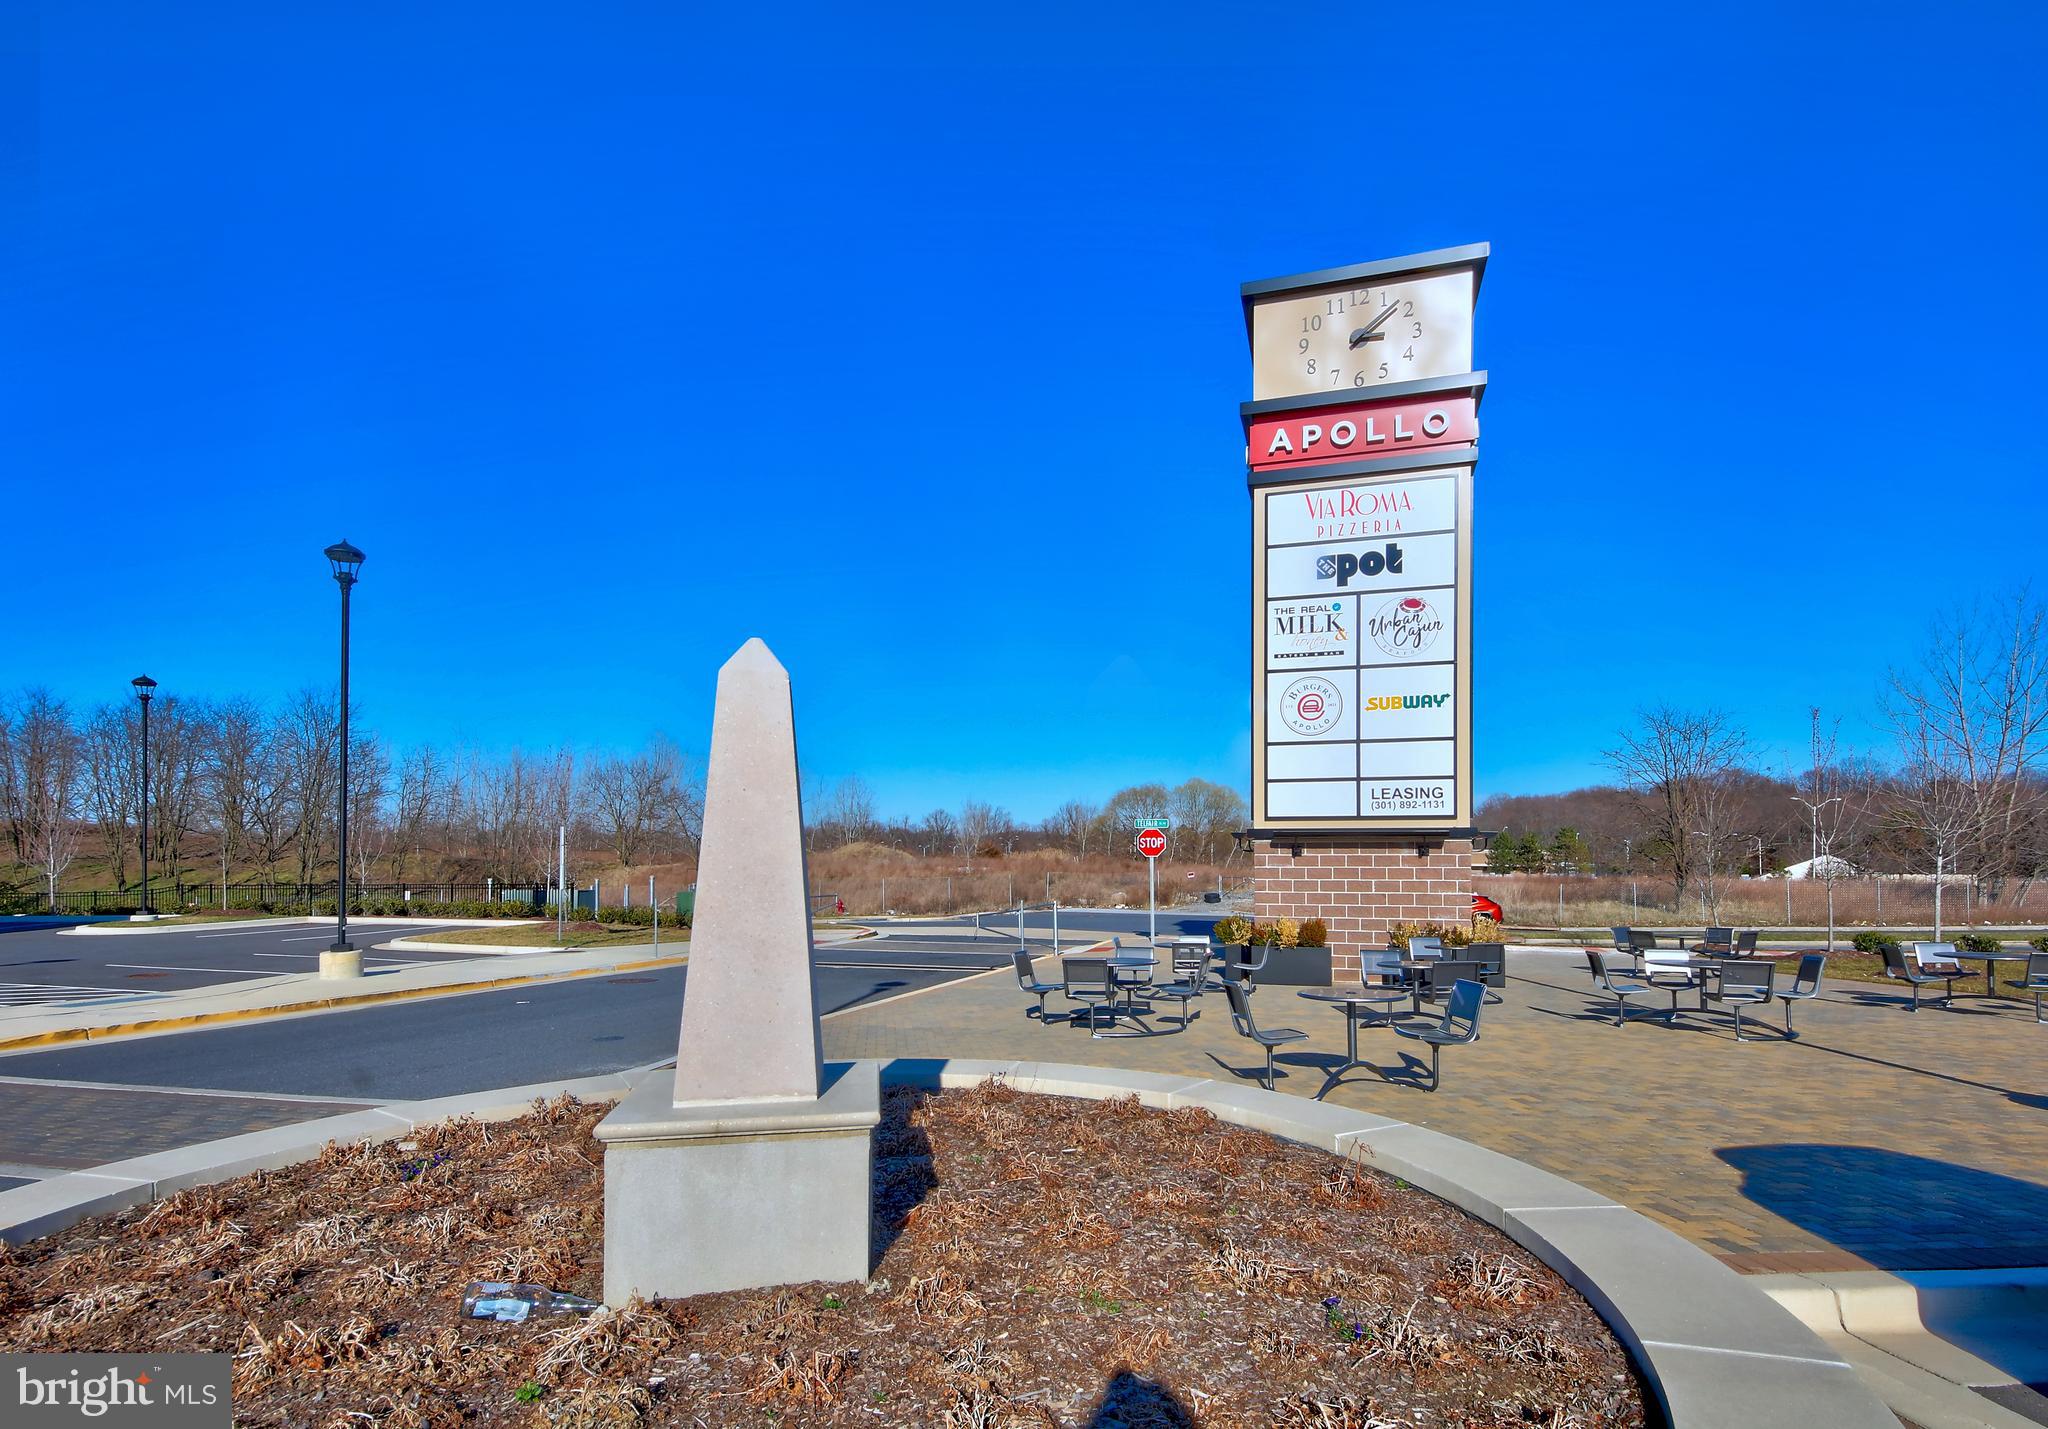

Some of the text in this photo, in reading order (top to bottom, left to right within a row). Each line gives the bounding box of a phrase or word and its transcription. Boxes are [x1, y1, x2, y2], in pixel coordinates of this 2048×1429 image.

[1349, 289, 1371, 307] 12
[1380, 291, 1387, 307] 1
[1326, 298, 1345, 316] 11
[1403, 301, 1415, 318] 2
[1301, 315, 1322, 333] 10
[1412, 322, 1422, 339] 3
[1298, 338, 1309, 355] 9
[1402, 345, 1415, 362] 4
[1306, 359, 1317, 375] 8
[1378, 362, 1389, 379] 5
[1330, 369, 1341, 385] 7
[1353, 370, 1365, 387] 6
[1268, 409, 1450, 457] APOLLO
[1304, 489, 1412, 520] VIA ROMA
[1317, 519, 1401, 538] PIZZERIA
[1318, 559, 1335, 576] THE
[1274, 604, 1331, 615] THE REAL
[1274, 613, 1343, 635] MILK
[1368, 607, 1423, 637] Urban
[1393, 620, 1444, 648] Cajun
[1288, 683, 1333, 700] BURGERS
[1365, 693, 1452, 712] SUBWAY
[1292, 718, 1330, 731] APOLLO
[1371, 787, 1444, 800] LEASING
[1370, 800, 1445, 811] (301) 892-1131
[1139, 837, 1164, 848] STOP
